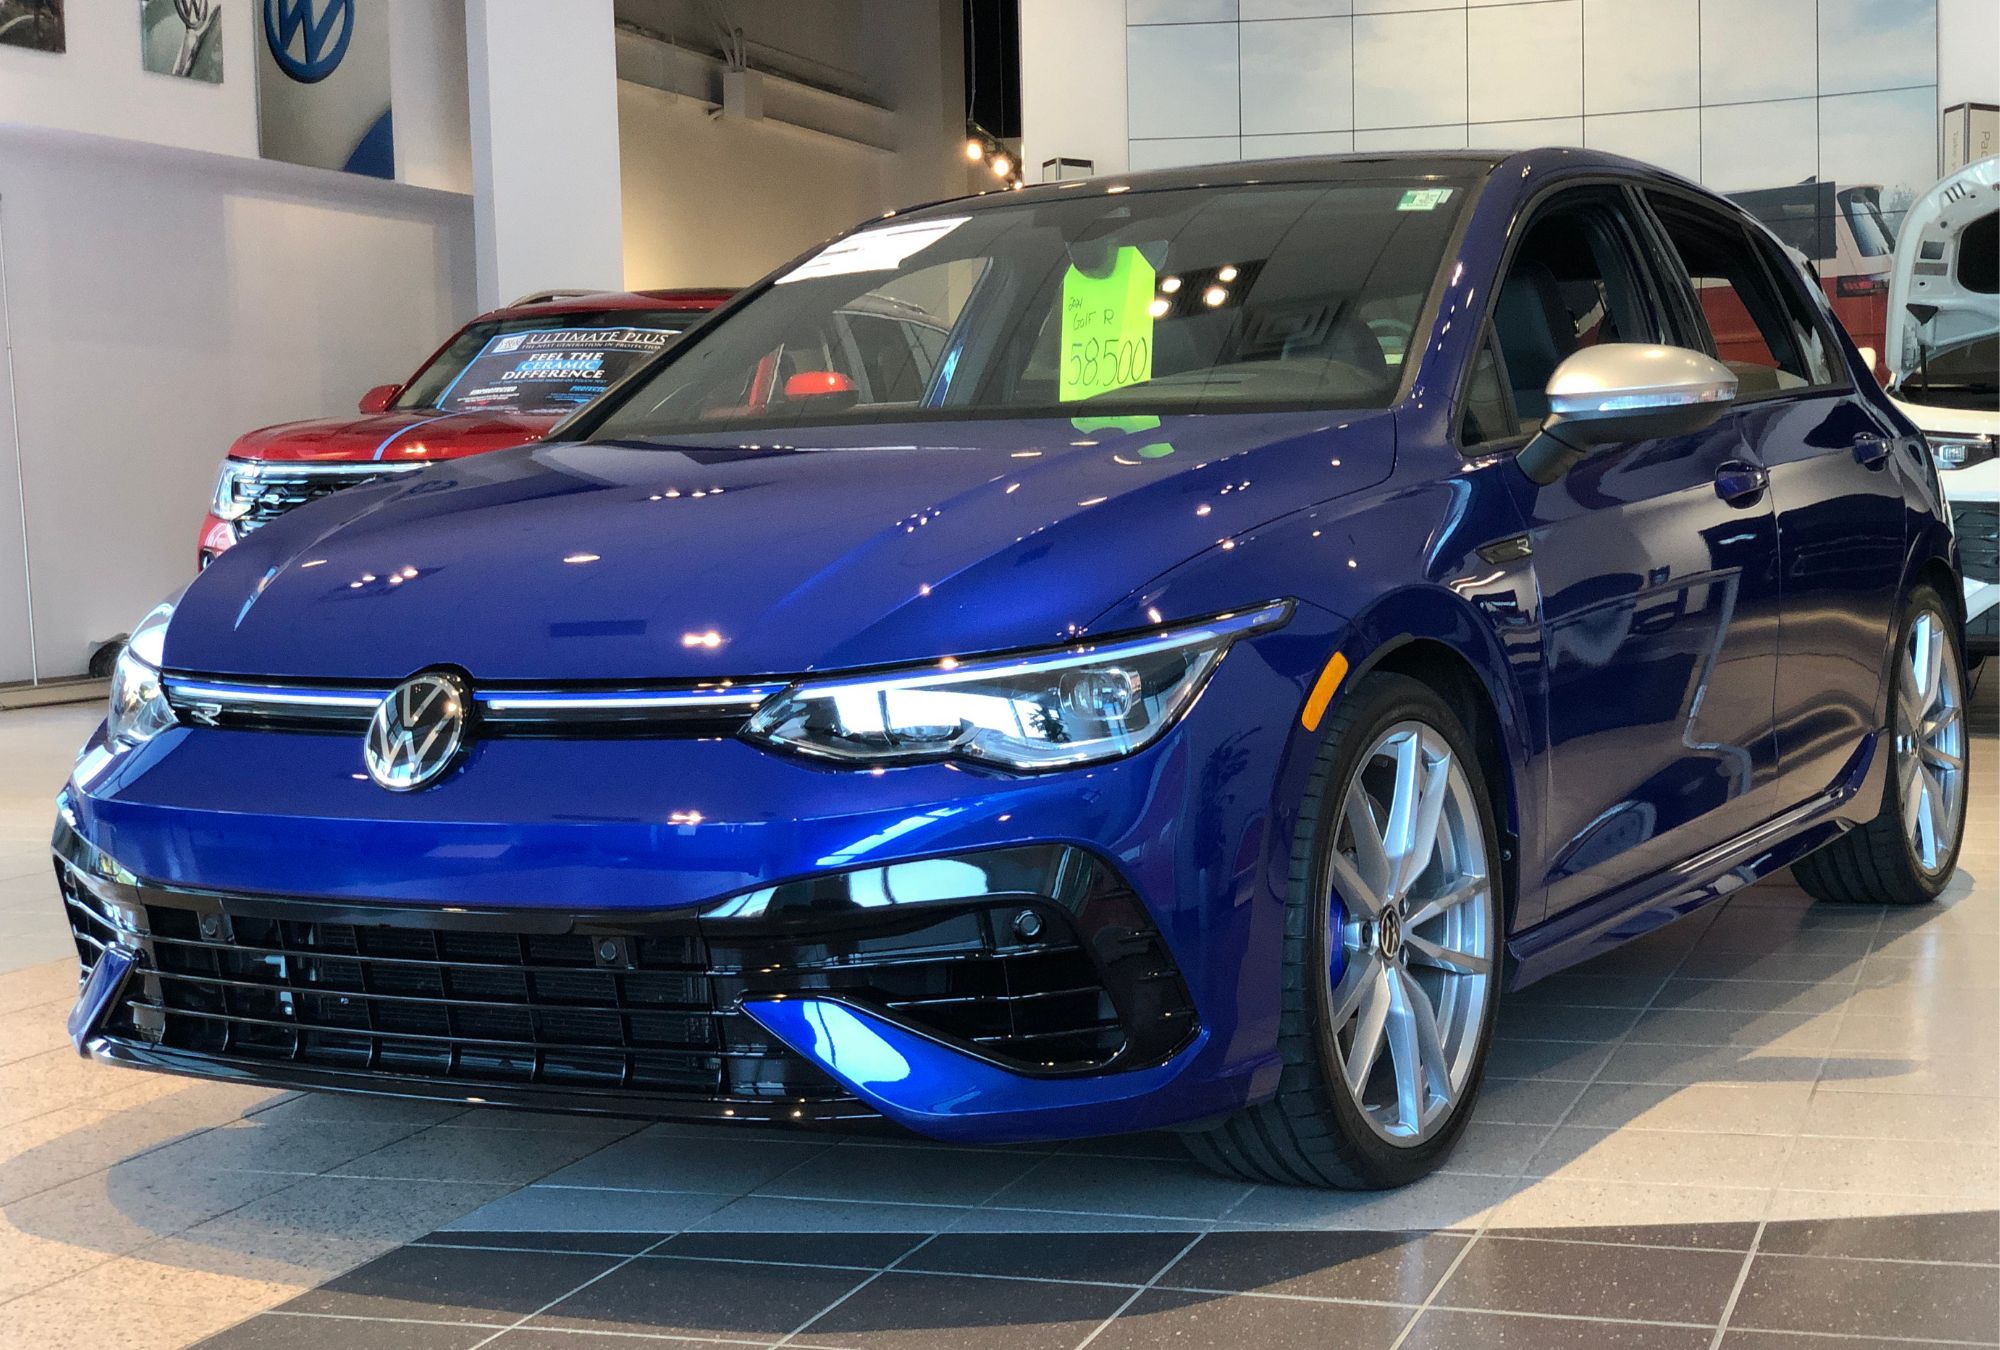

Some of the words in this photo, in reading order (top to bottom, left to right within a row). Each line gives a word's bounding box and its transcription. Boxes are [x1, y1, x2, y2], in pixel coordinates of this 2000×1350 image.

[1103, 308, 1115, 325] R
[528, 331, 620, 344] ULTIMATE
[621, 332, 669, 345] PLUS
[615, 342, 662, 350] PROTECTION
[528, 352, 563, 361] FEEL
[566, 352, 605, 361] THE
[1068, 336, 1148, 386] 58,500
[521, 361, 598, 370] CERAMIC
[501, 370, 606, 380] DIFFERENCE
